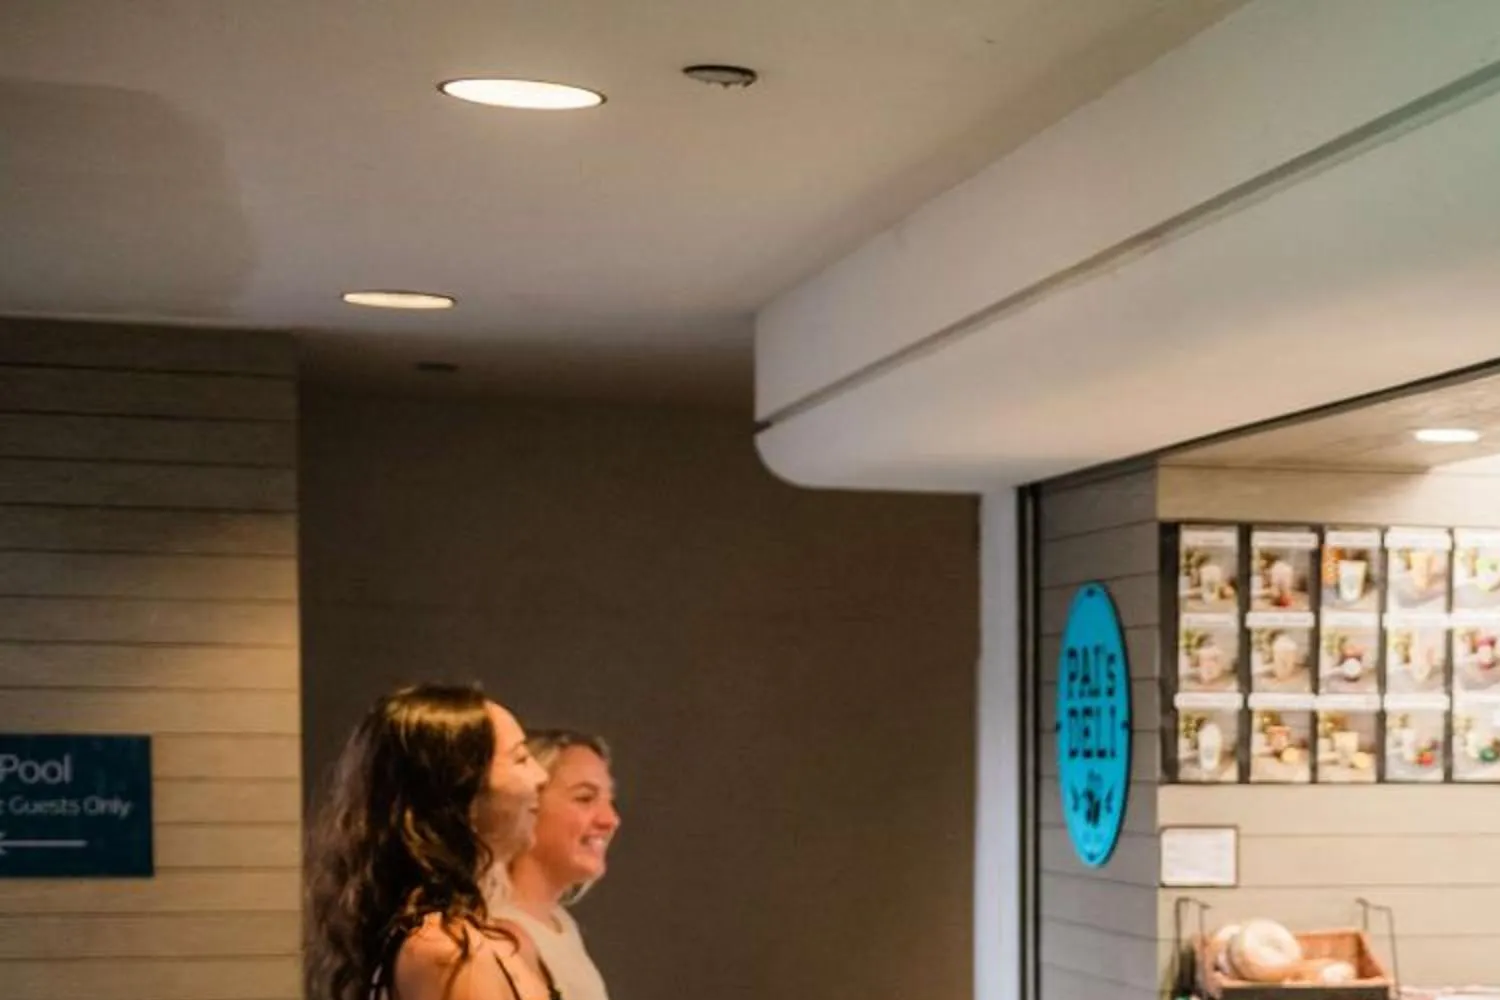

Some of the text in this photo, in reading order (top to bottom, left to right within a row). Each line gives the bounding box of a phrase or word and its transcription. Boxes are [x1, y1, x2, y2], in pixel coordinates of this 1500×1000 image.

[0, 753, 73, 785] Pool
[9, 797, 80, 816] Guests
[84, 796, 131, 819] Only
